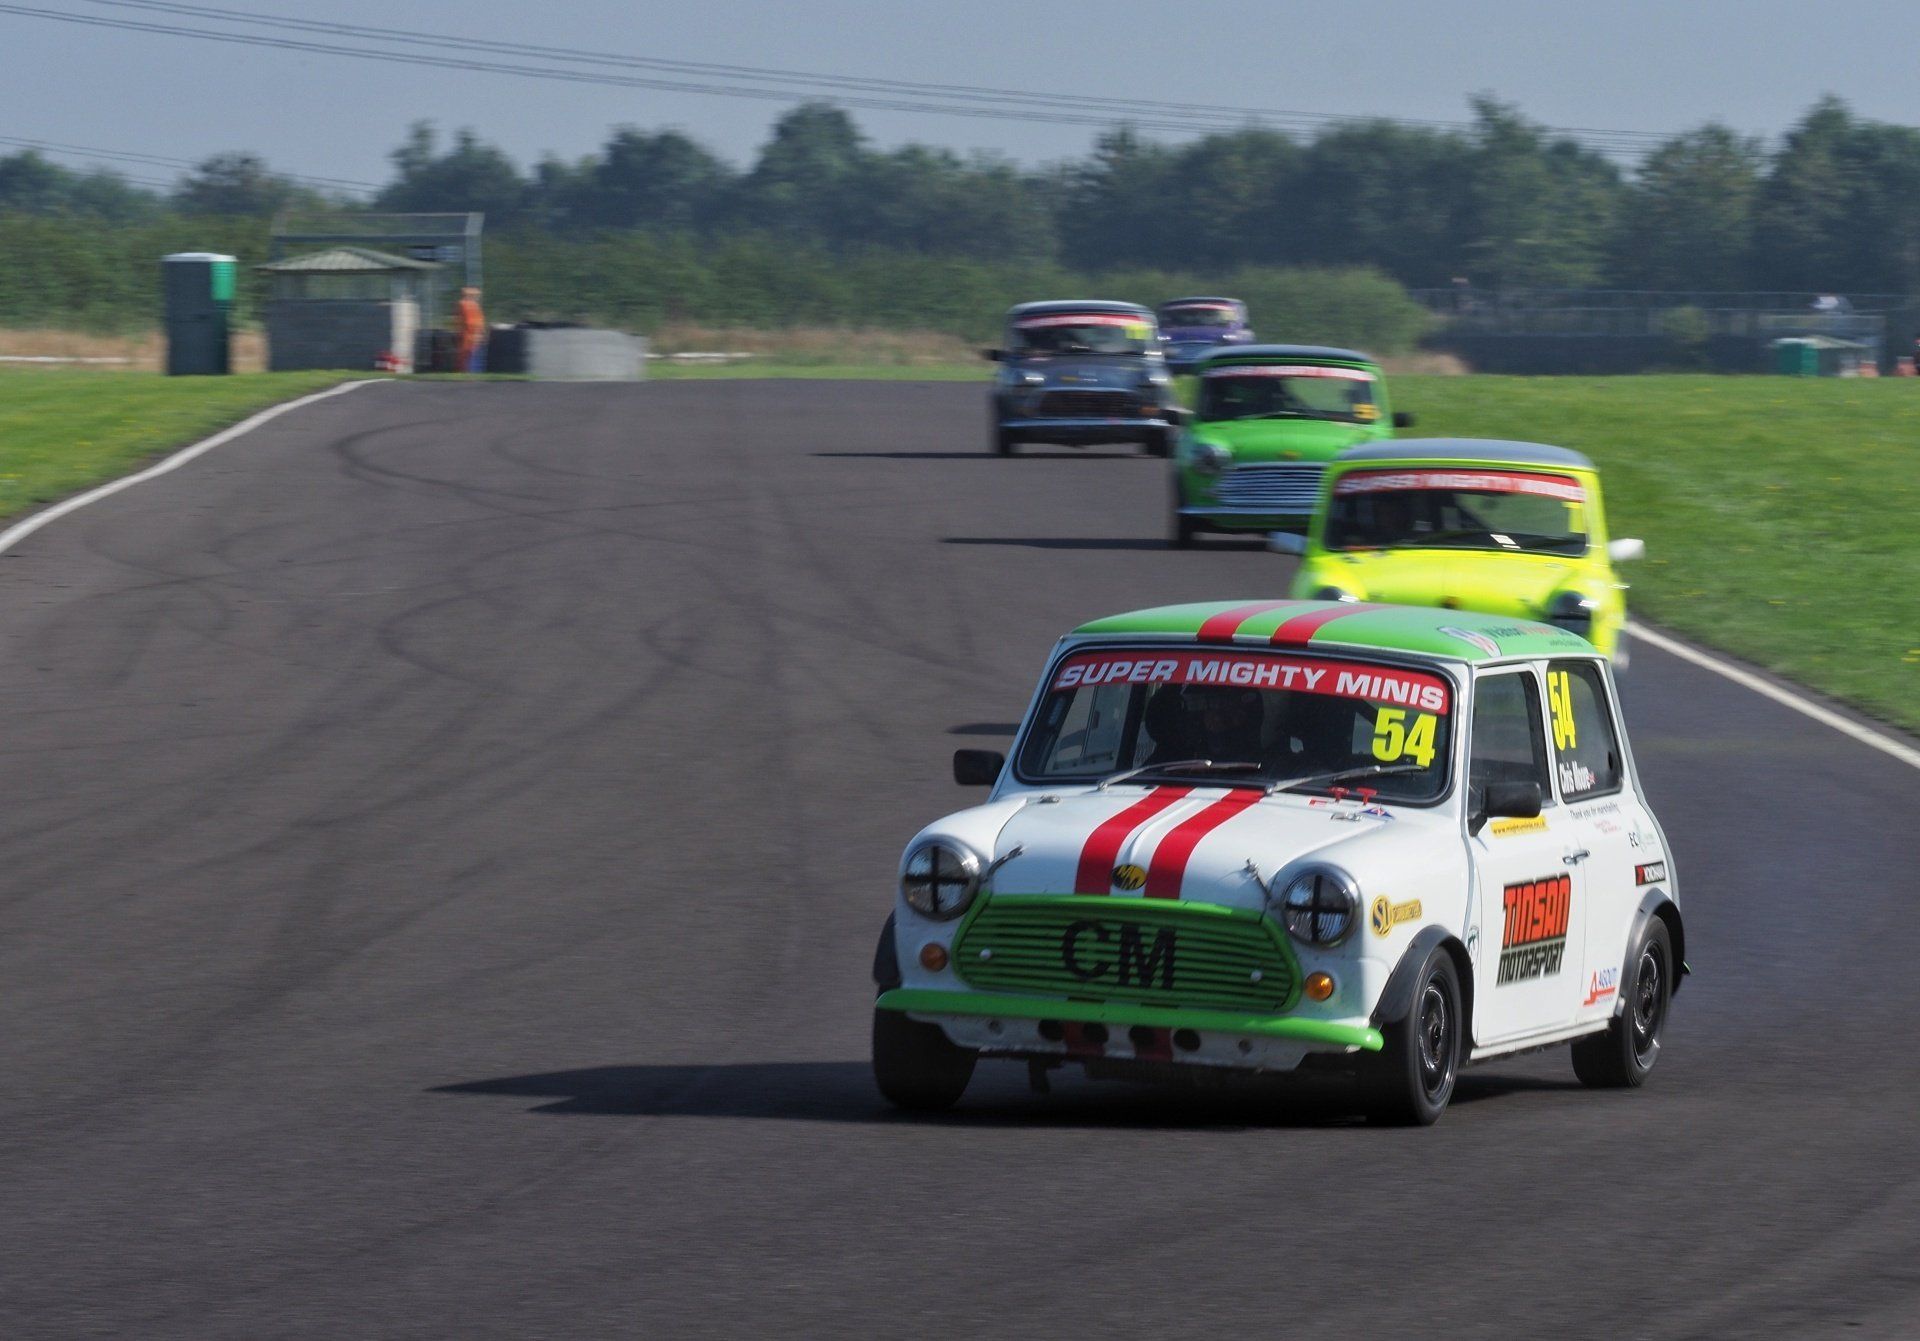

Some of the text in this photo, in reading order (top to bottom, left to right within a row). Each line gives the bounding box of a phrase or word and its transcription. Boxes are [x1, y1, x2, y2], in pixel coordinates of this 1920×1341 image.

[1057, 660, 1443, 710] SUPER MIGHTY MINIS
[1547, 671, 1576, 751] 54
[1372, 707, 1437, 767] 54
[1503, 874, 1571, 949] TINSAN
[1060, 920, 1176, 991] CM
[1497, 942, 1566, 986] MOTORSPORT
